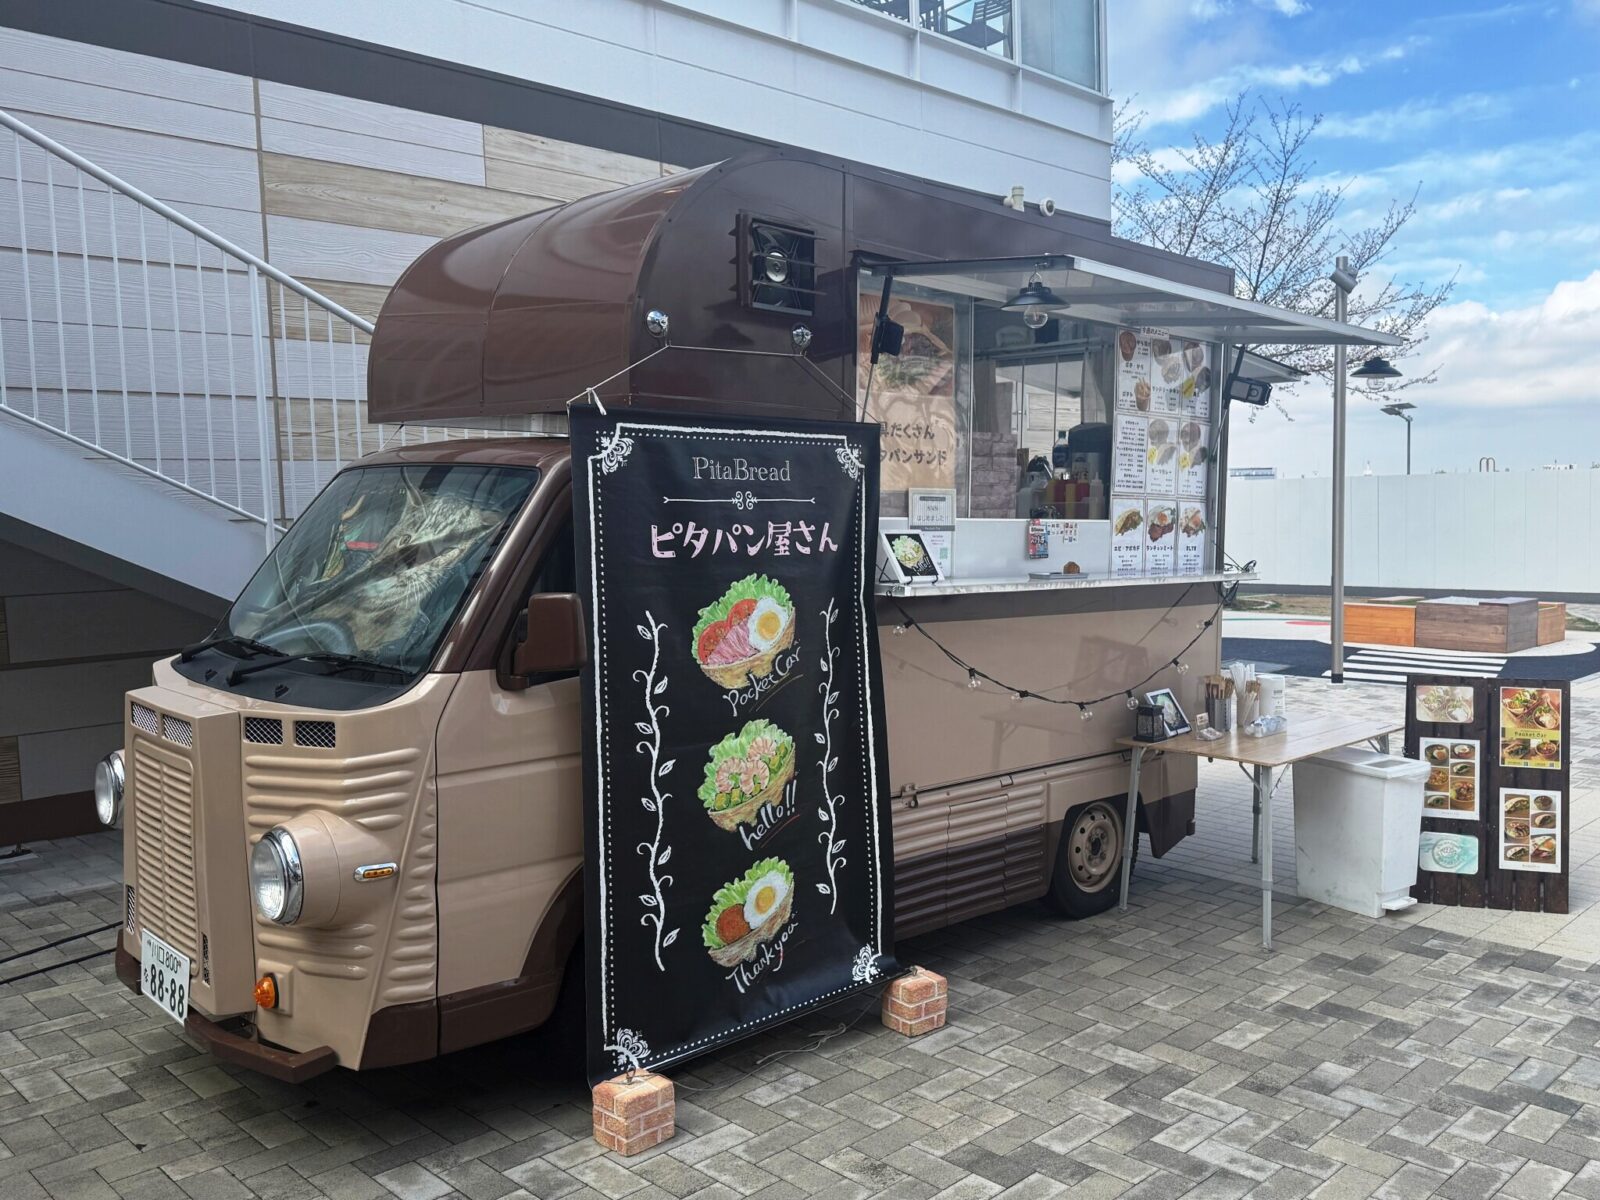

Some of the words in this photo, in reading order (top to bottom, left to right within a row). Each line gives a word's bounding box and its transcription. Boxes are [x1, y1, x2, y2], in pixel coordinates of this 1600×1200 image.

[691, 456, 791, 481] PitaBread
[651, 520, 839, 559] ピタパン屋さん
[722, 673, 780, 717] Pocket
[775, 646, 801, 675] Car
[739, 780, 797, 851] hello!!
[150, 963, 185, 1018] 88-88
[725, 943, 776, 993] Thank
